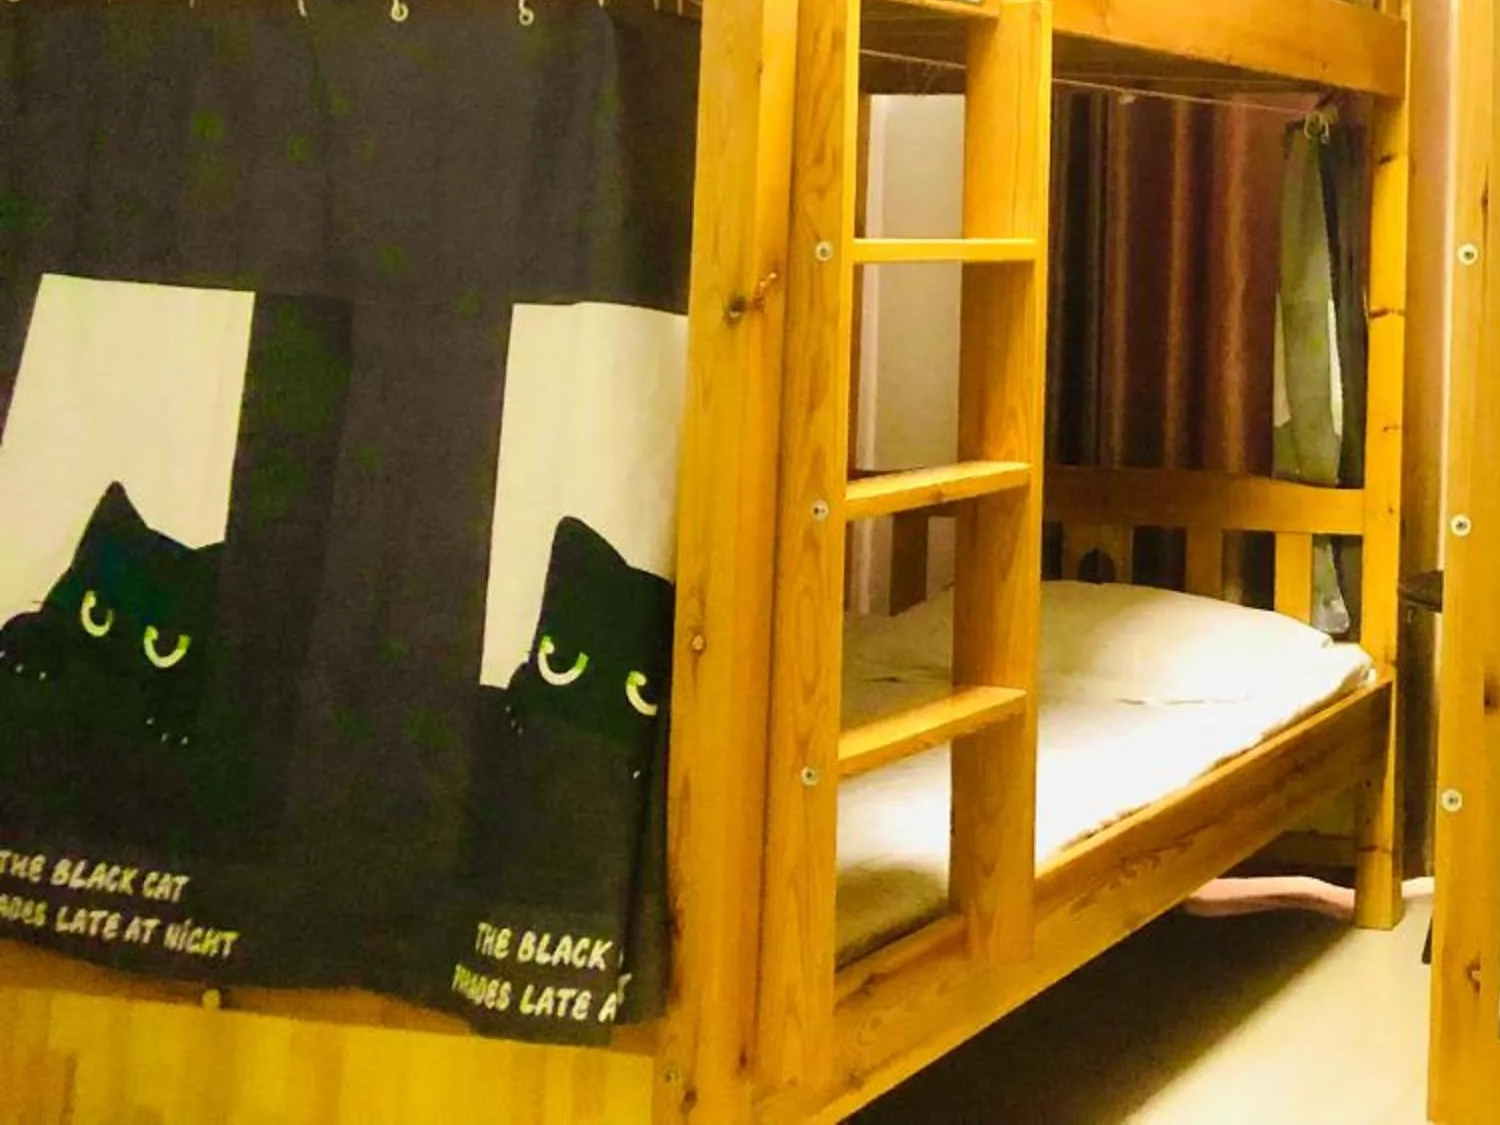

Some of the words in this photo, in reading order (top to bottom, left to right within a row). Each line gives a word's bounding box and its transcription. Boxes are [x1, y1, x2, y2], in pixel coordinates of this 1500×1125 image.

[50, 857, 140, 896] BLACK
[142, 871, 190, 903] CAT
[55, 905, 122, 941] LATE
[123, 915, 161, 945] AT
[475, 922, 513, 960] THE
[517, 930, 614, 972] BLACK
[519, 984, 593, 1021] LATE
